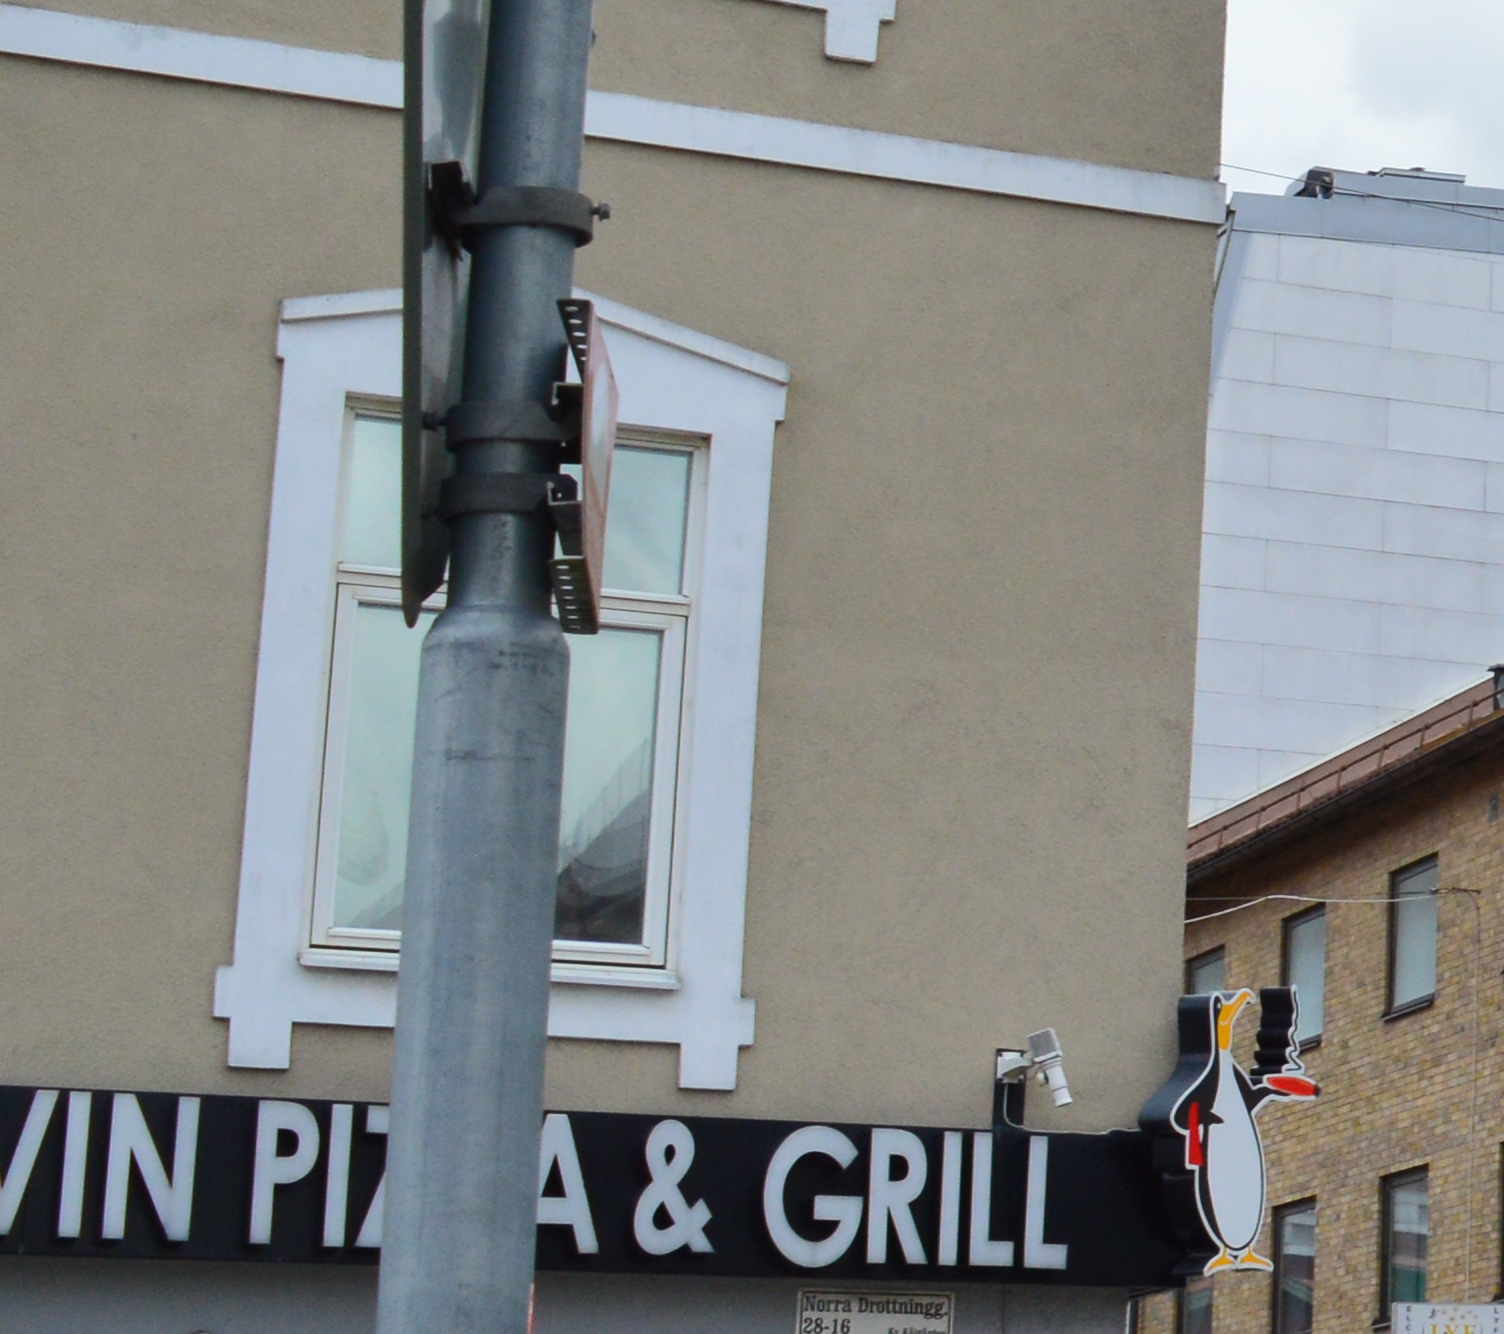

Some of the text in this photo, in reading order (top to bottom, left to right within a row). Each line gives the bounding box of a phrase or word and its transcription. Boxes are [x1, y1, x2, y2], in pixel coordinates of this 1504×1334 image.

[248, 1099, 599, 1255] PIA
[633, 1119, 715, 1256] &
[763, 1125, 1069, 1269] GRILL
[804, 1295, 948, 1320] Norra Drottningg.
[803, 1317, 851, 1334] 28-16
